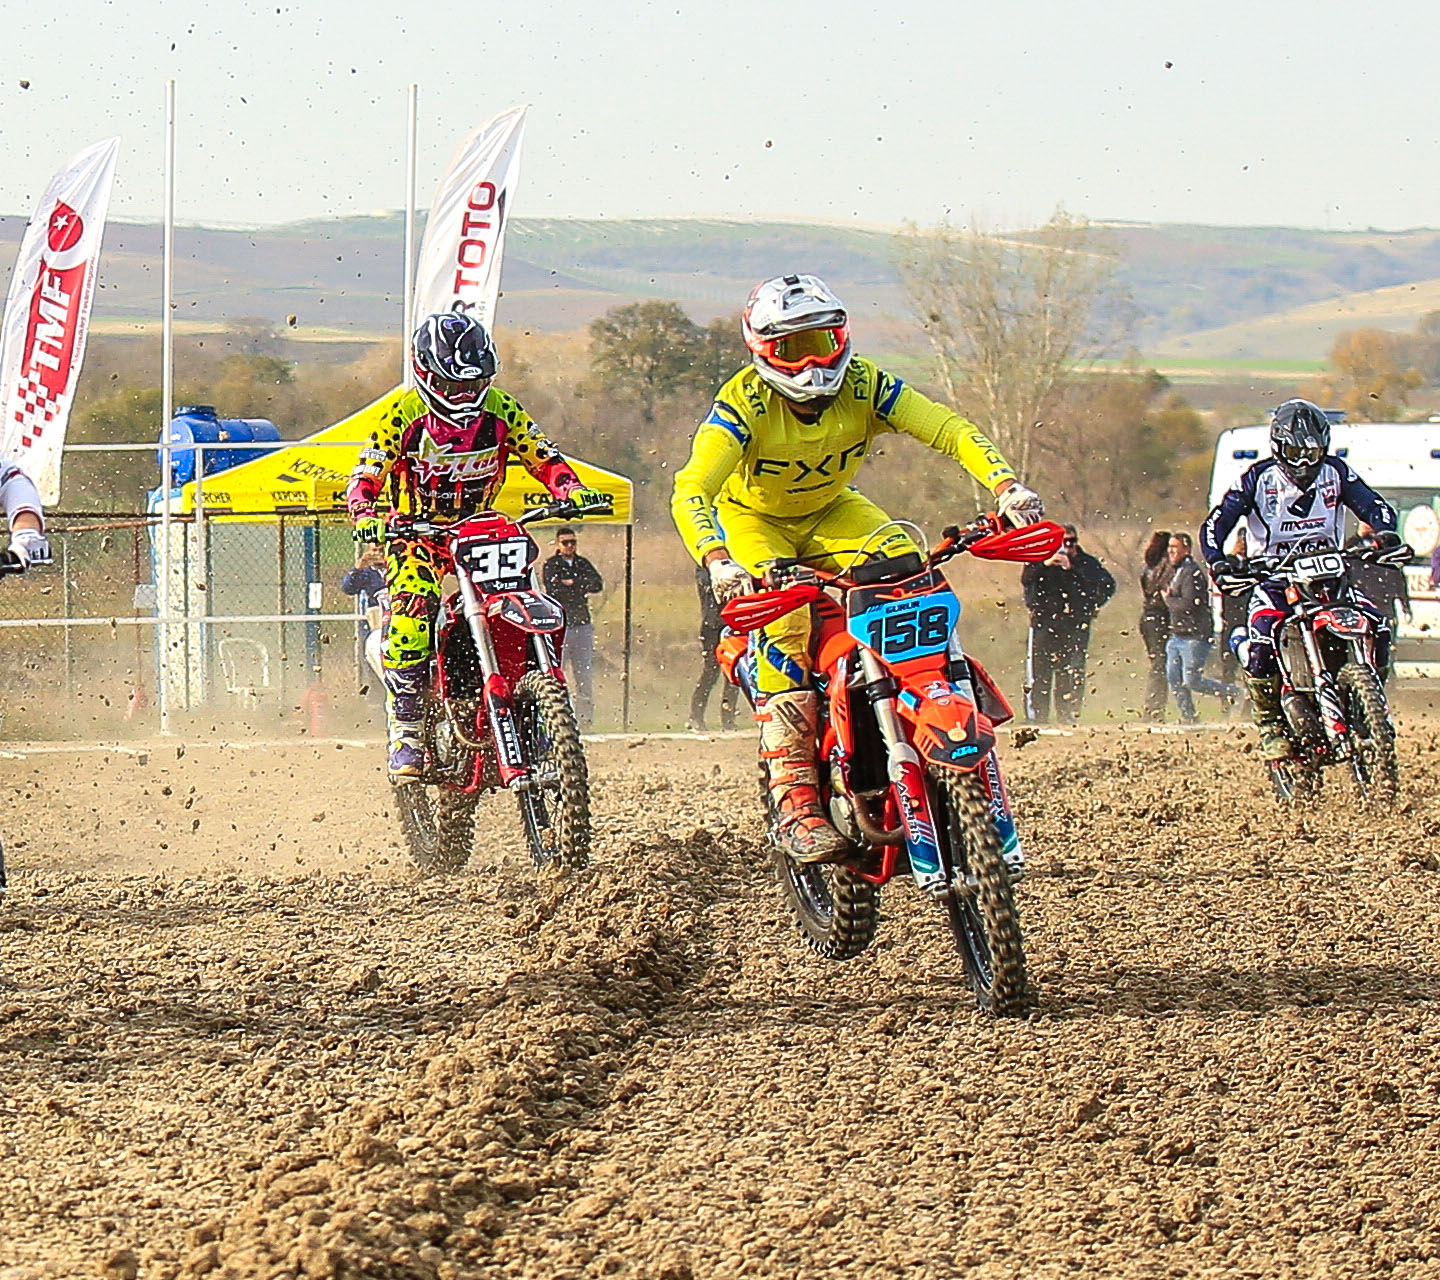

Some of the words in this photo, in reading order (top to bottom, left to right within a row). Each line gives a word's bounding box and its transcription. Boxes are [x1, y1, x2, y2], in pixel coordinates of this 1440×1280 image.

[29, 271, 71, 371] TMF
[470, 541, 529, 583] 33
[867, 605, 950, 654] 158
